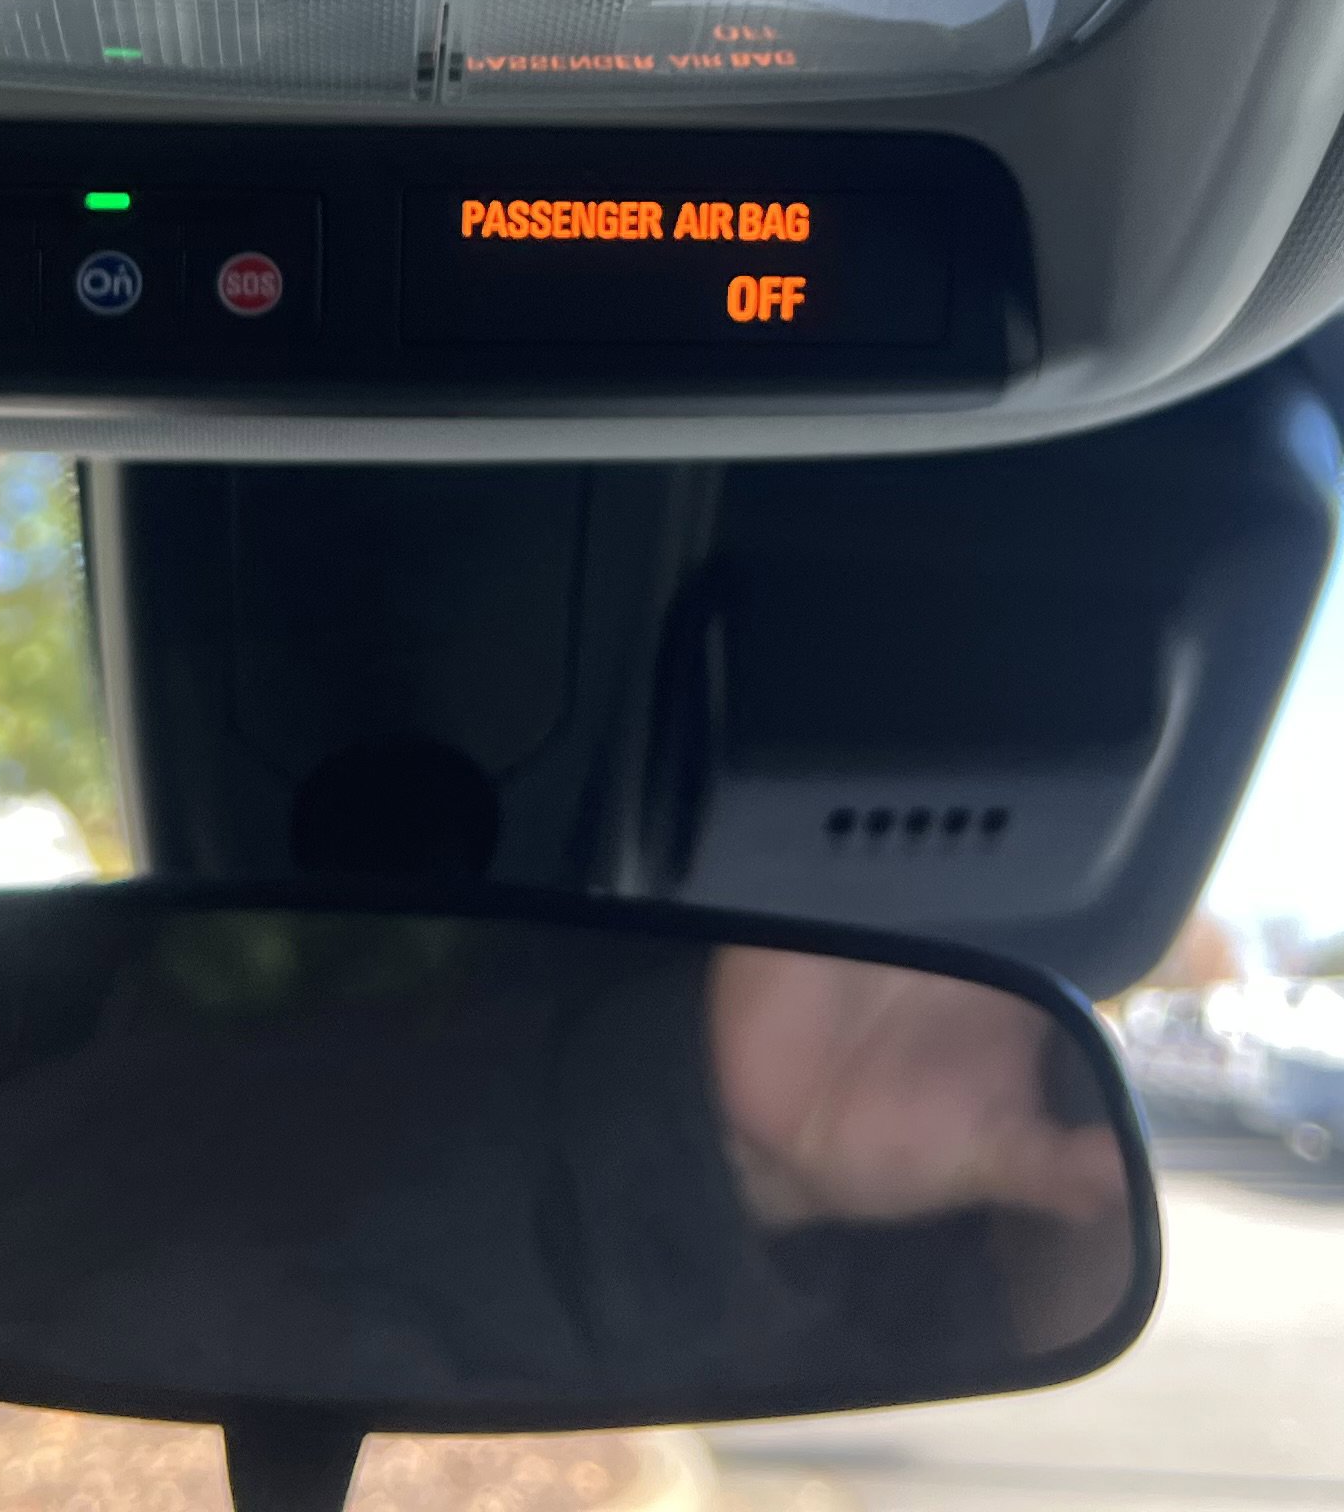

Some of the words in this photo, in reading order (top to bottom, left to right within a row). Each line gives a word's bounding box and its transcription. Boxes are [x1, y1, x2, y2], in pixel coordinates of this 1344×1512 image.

[461, 199, 664, 240] PASSENGER
[673, 201, 735, 241] AIR
[738, 202, 811, 242] BAG
[225, 269, 277, 298] SOS
[727, 275, 807, 323] OFF
